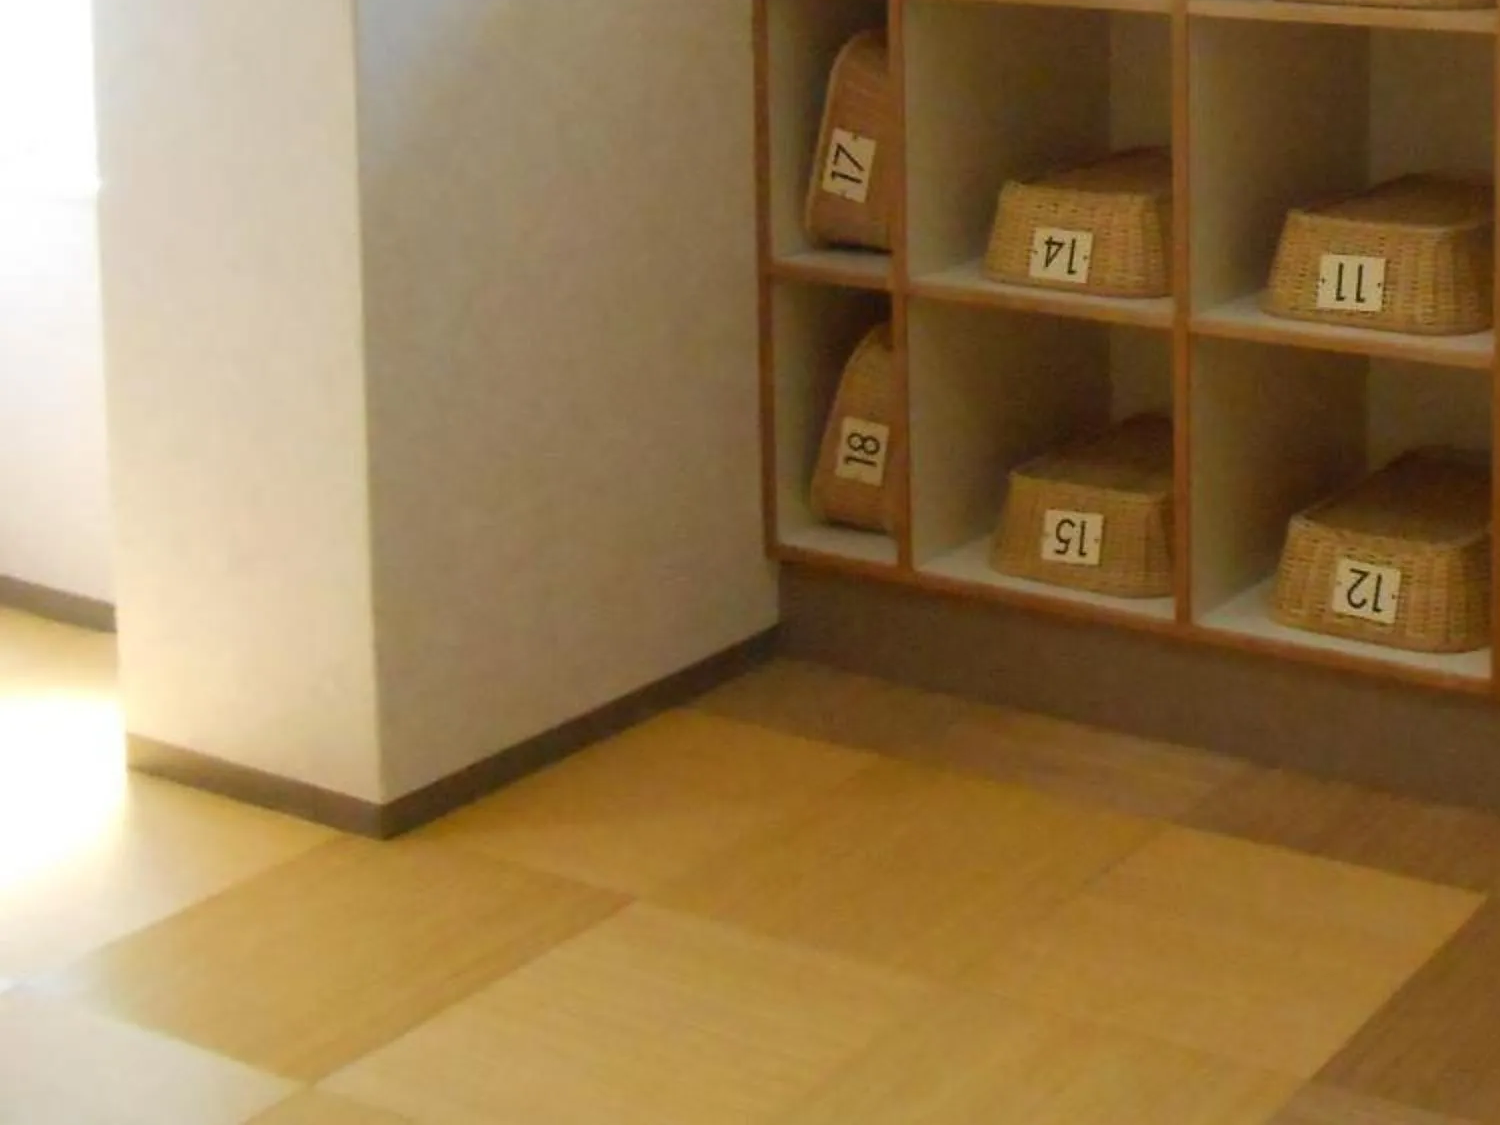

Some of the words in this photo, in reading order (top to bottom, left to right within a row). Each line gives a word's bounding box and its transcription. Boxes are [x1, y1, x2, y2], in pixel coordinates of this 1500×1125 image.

[831, 143, 865, 186] 17
[1043, 235, 1077, 276] 14
[1335, 262, 1366, 304] 11
[845, 433, 879, 469] 18
[1053, 518, 1088, 558] 15
[1346, 567, 1383, 614] 12
